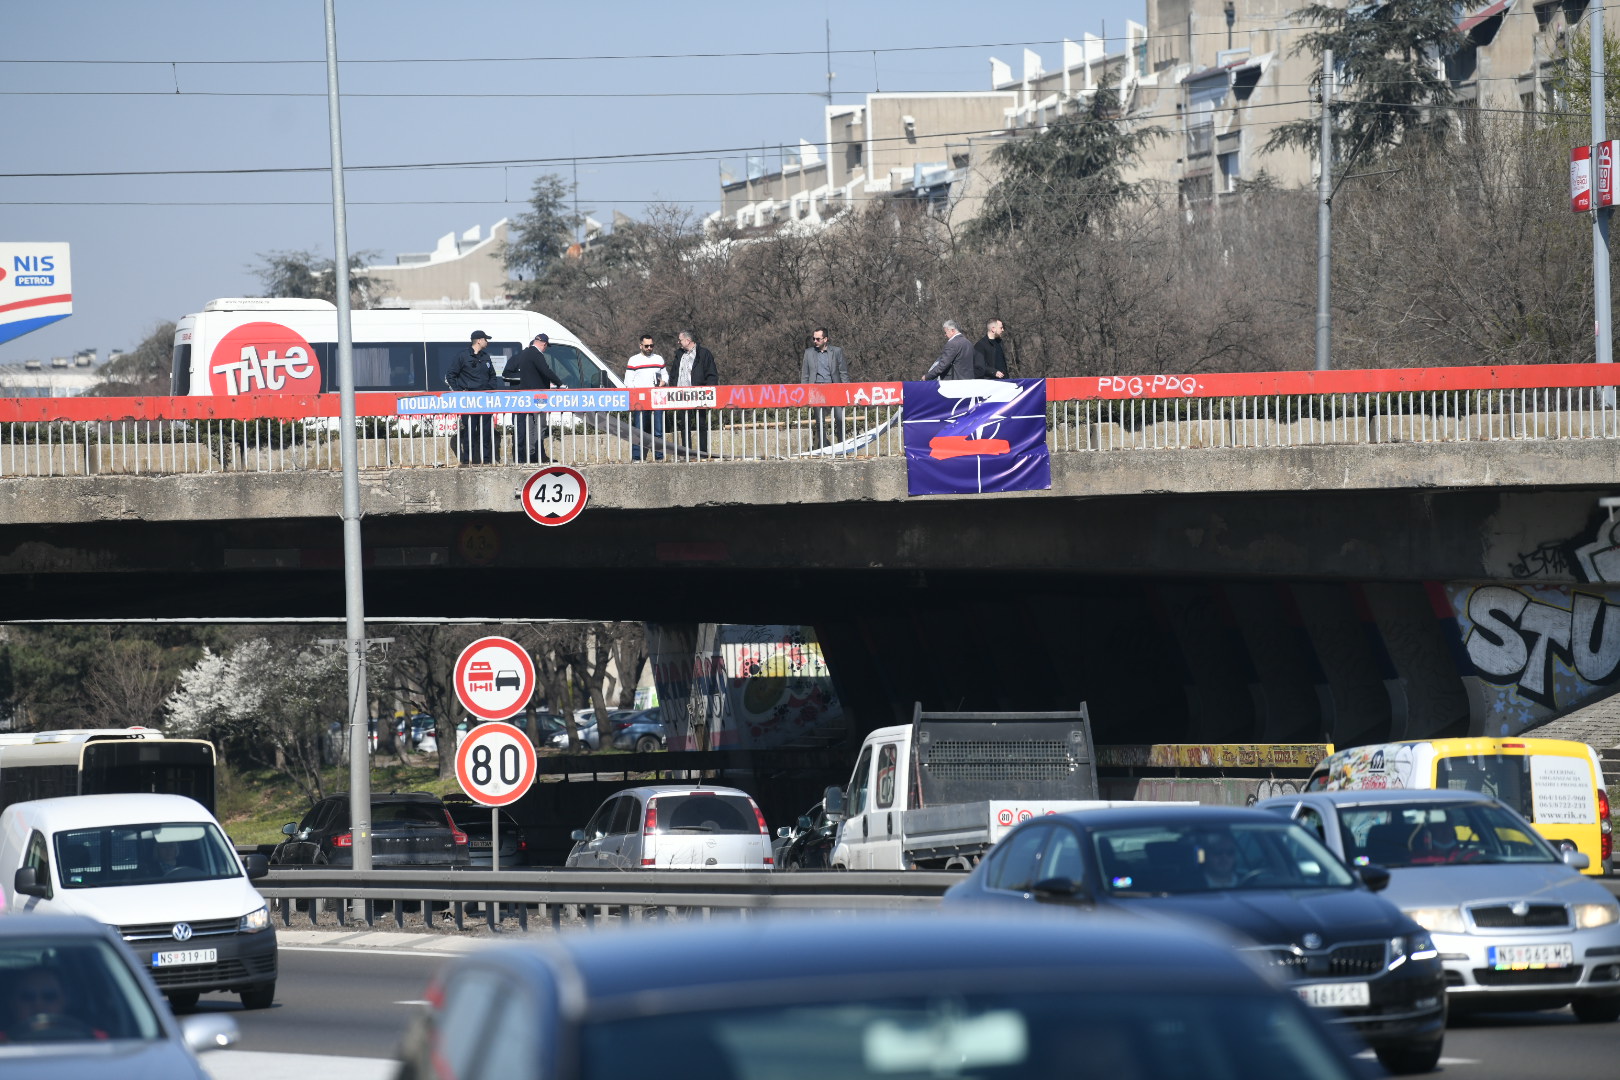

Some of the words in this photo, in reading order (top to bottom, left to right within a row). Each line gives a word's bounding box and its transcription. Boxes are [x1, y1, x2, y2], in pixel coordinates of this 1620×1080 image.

[13, 255, 55, 272] NIS
[18, 276, 52, 285] PETROL
[400, 395, 457, 410] ПОШАЉИ
[459, 395, 483, 409] СМС
[485, 395, 502, 408] НА
[504, 395, 532, 408] 7763
[548, 394, 579, 408] СРБИ
[581, 394, 596, 408] ЗА
[598, 393, 626, 408] СРБЕ
[471, 743, 521, 786] 80
[1001, 813, 1010, 822] 80
[1540, 811, 1587, 819] www.rik.rs
[160, 953, 173, 964] NS
[180, 951, 199, 962] 319
